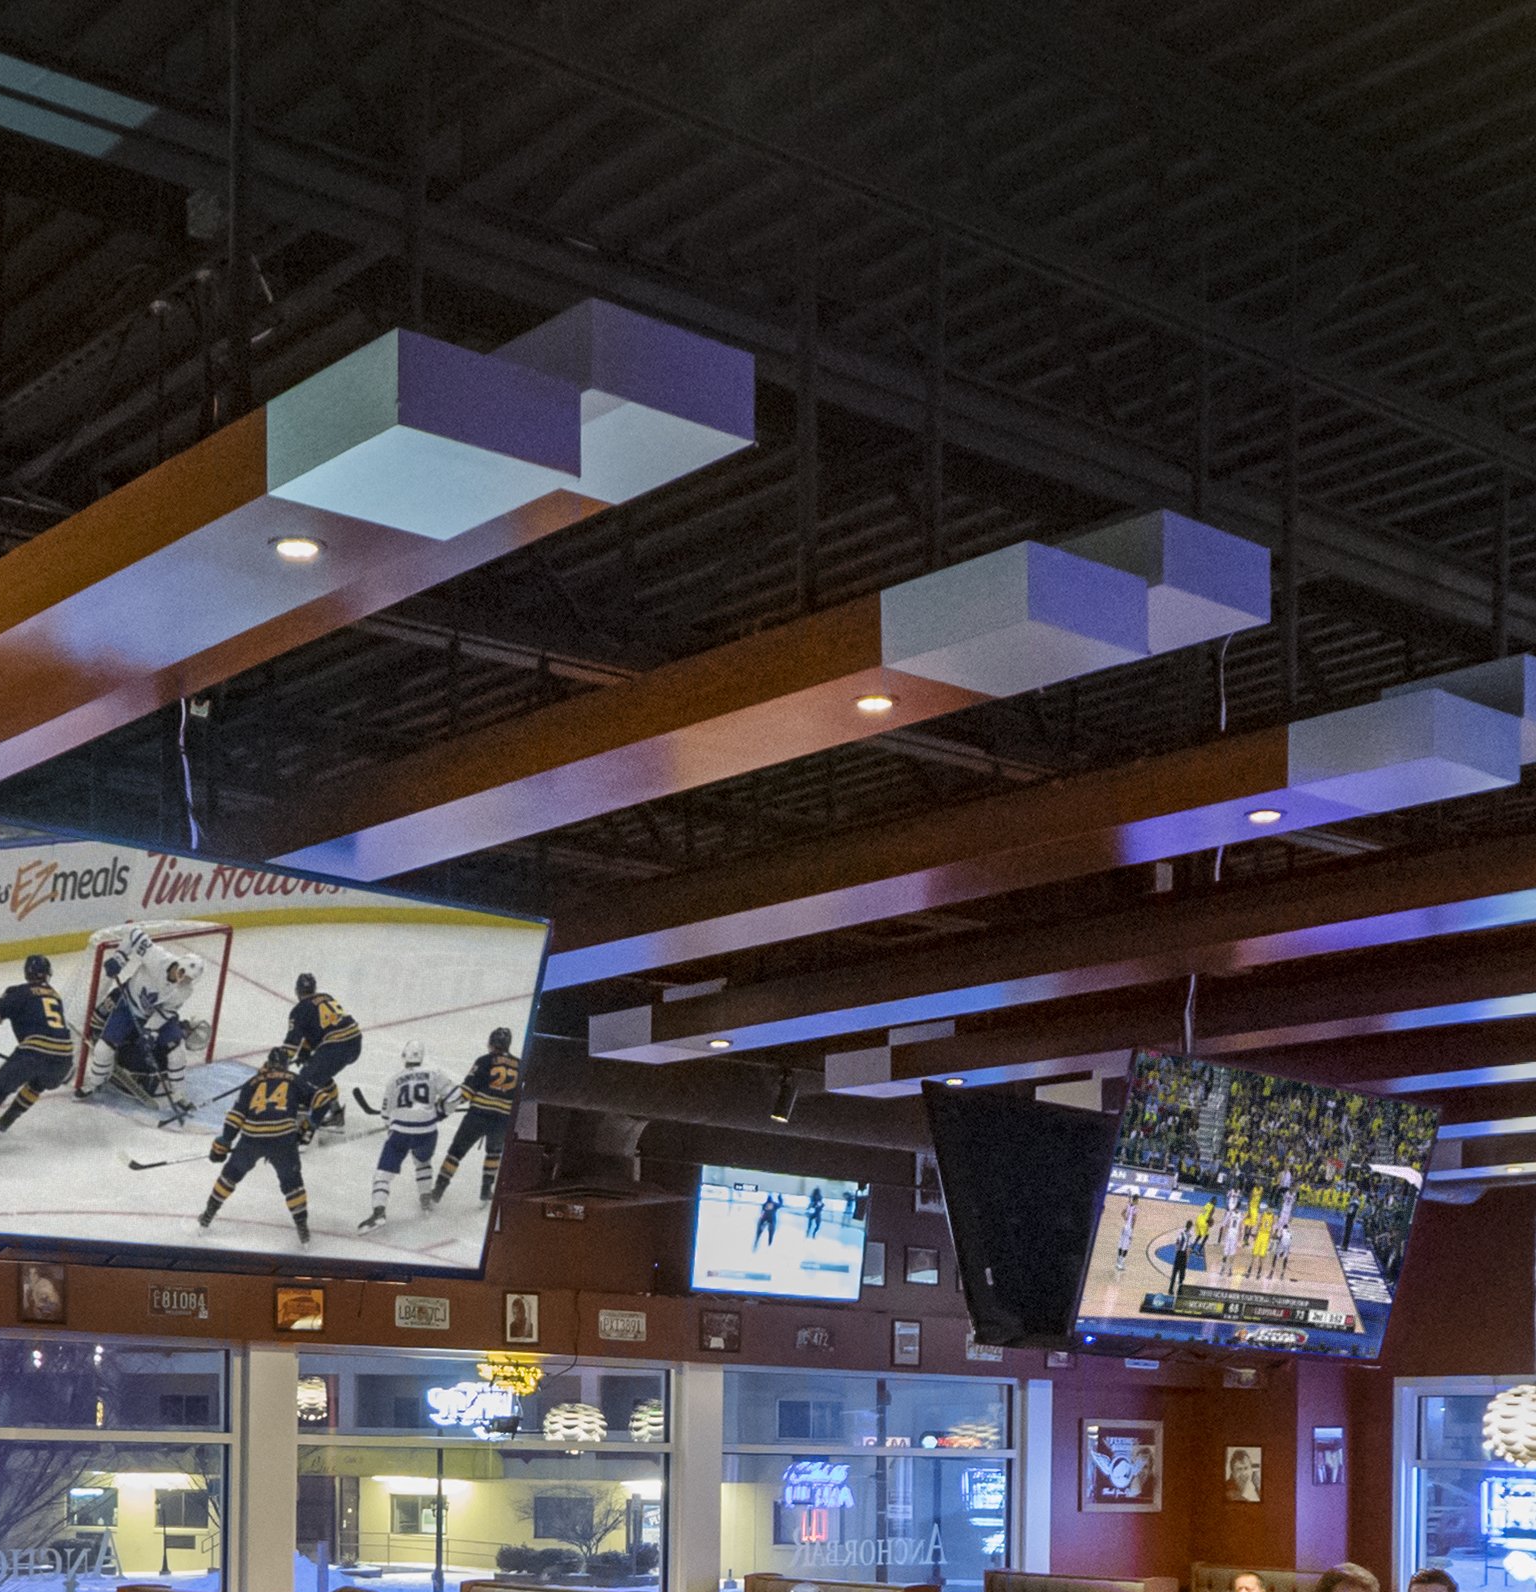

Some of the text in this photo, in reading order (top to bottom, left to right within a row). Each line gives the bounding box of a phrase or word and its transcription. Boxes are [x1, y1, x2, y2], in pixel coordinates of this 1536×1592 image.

[141, 852, 203, 909] Tim
[42, 998, 64, 1029] 5
[249, 1081, 288, 1113] 44
